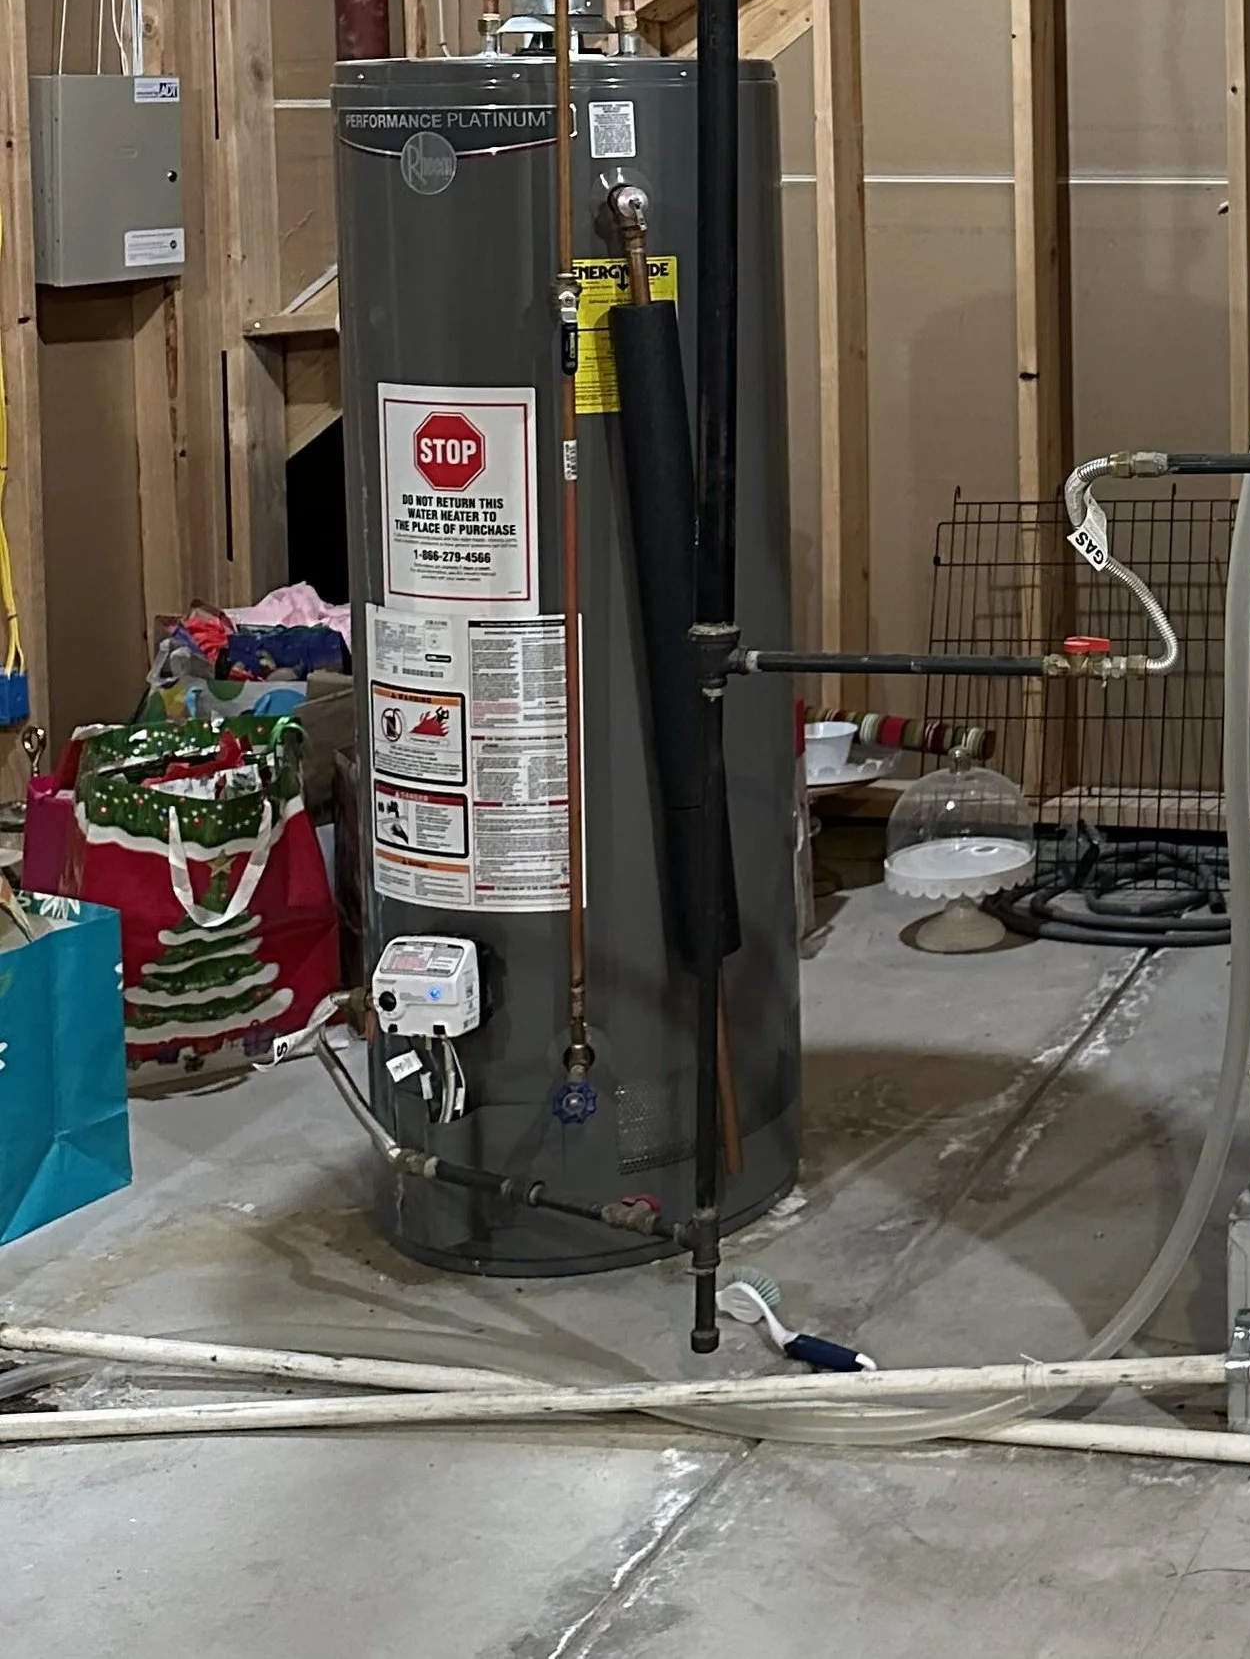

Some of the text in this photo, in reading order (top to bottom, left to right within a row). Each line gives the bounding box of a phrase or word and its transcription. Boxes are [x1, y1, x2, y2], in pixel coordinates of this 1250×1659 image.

[345, 113, 442, 129] PERFORMANCE
[420, 437, 478, 465] STOP
[402, 494, 504, 510] DO NOT RETURN THIS
[408, 508, 497, 523] WATER HEATER TO
[395, 519, 517, 536] THE PLACE OF PURCHASE
[413, 549, 492, 564] 1-866-279-4566
[1074, 531, 1106, 567] GAS
